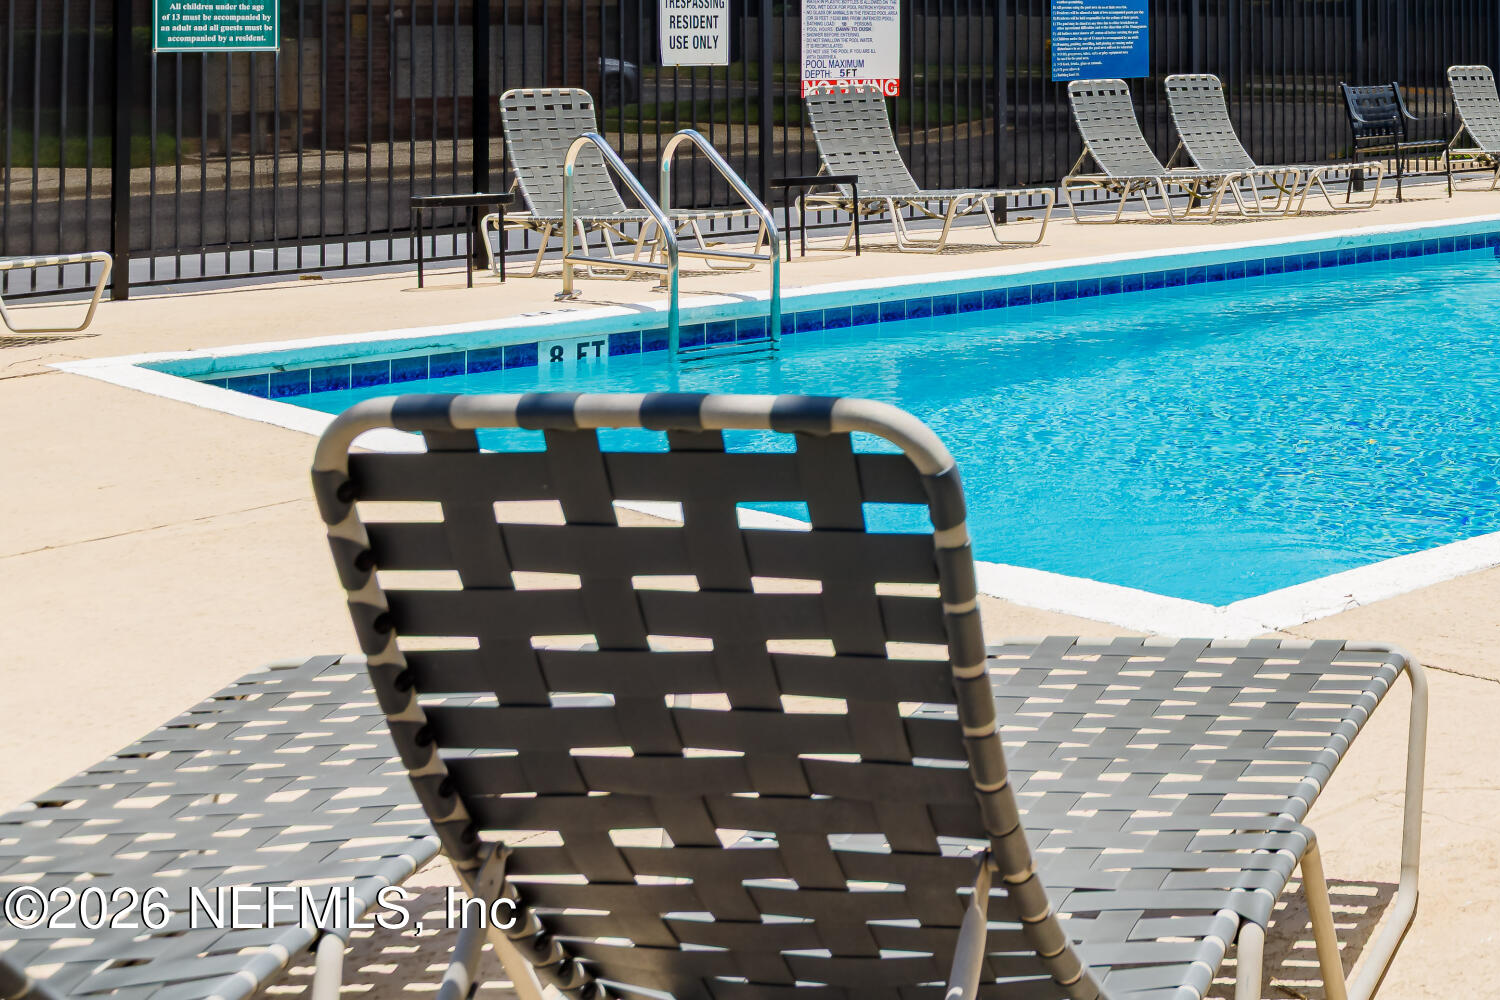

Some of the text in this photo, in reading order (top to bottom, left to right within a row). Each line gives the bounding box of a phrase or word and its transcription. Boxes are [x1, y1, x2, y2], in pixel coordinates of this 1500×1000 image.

[214, 14, 260, 22] accompanied
[670, 15, 718, 29] RESIDENT
[168, 35, 216, 43] accompanied
[670, 35, 718, 49] USE ONLY
[806, 59, 864, 68] POOL MAXIMUM
[805, 70, 832, 78] DEPTH:
[550, 340, 605, 362] 8 FT
